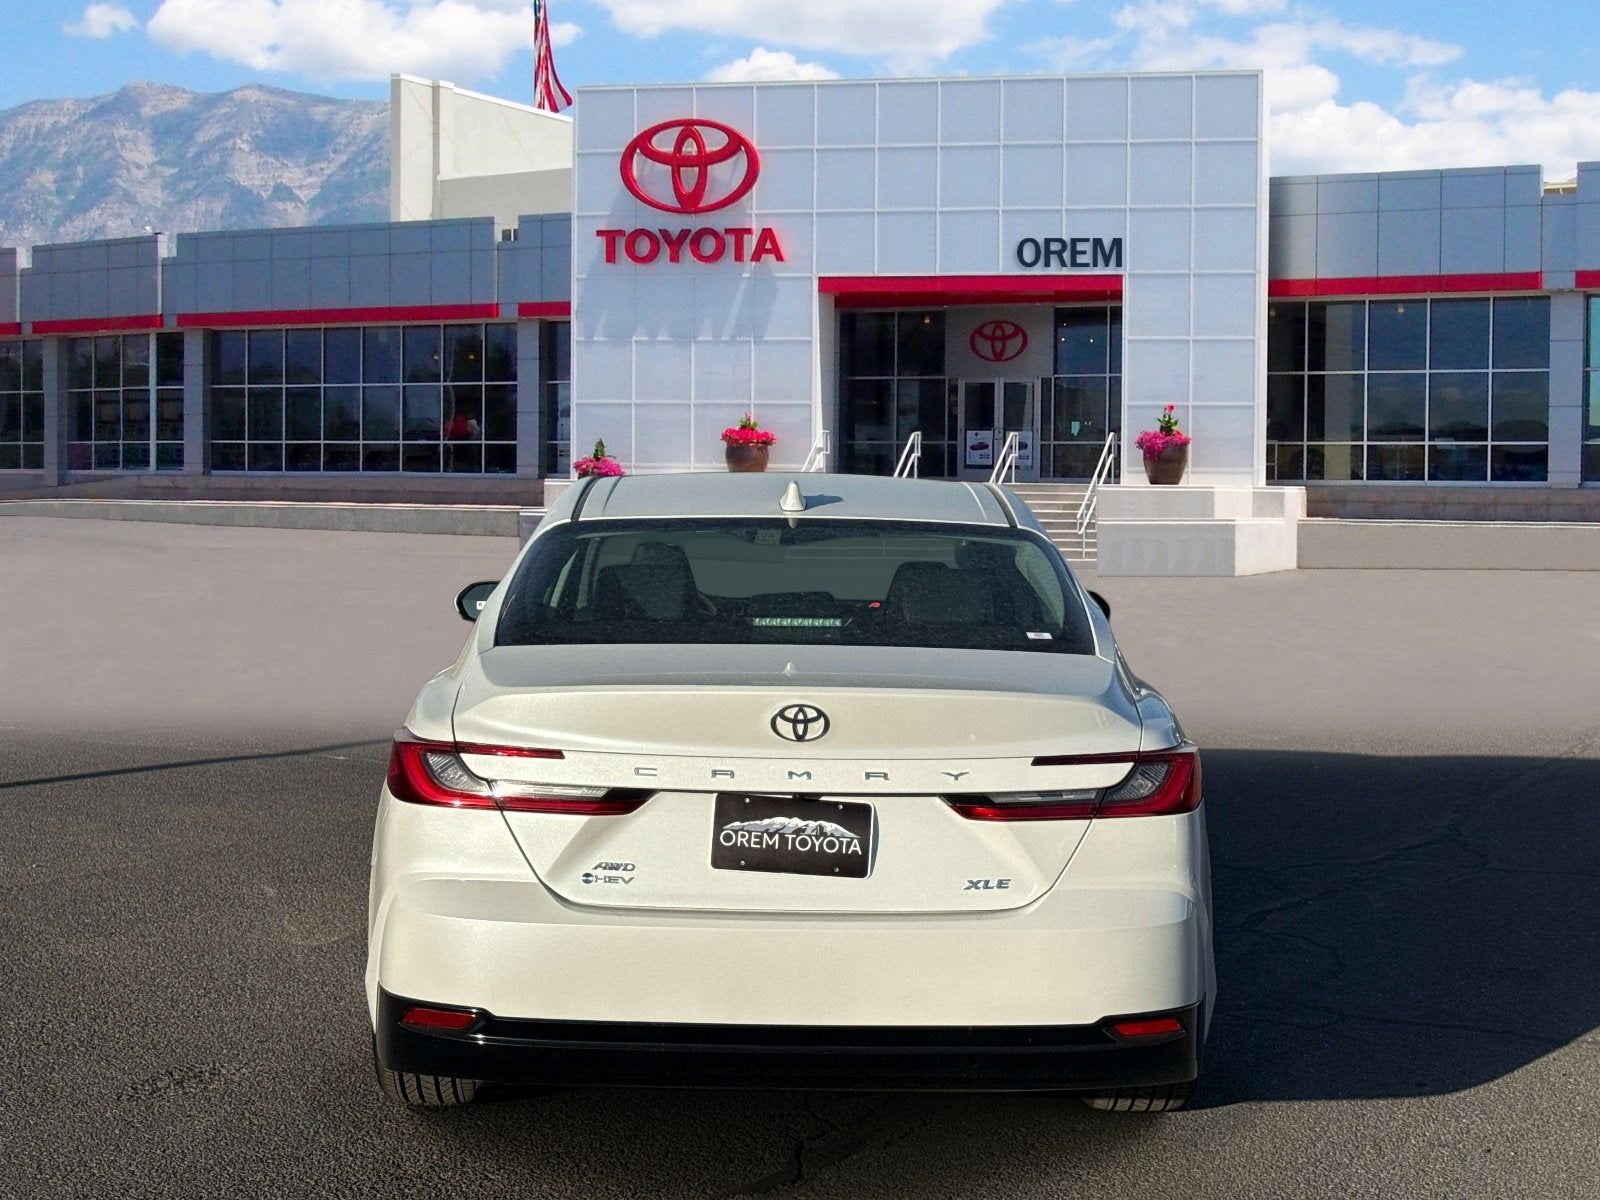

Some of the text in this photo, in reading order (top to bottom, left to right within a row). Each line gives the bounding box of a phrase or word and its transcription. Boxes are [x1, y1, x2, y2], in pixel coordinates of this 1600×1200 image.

[596, 227, 784, 264] TOYOTA
[1017, 237, 1122, 268] OREM
[634, 766, 970, 781] CAMRY
[720, 829, 862, 855] OREM TOYOTA
[592, 861, 636, 872] AWD
[963, 878, 1012, 890] XLE
